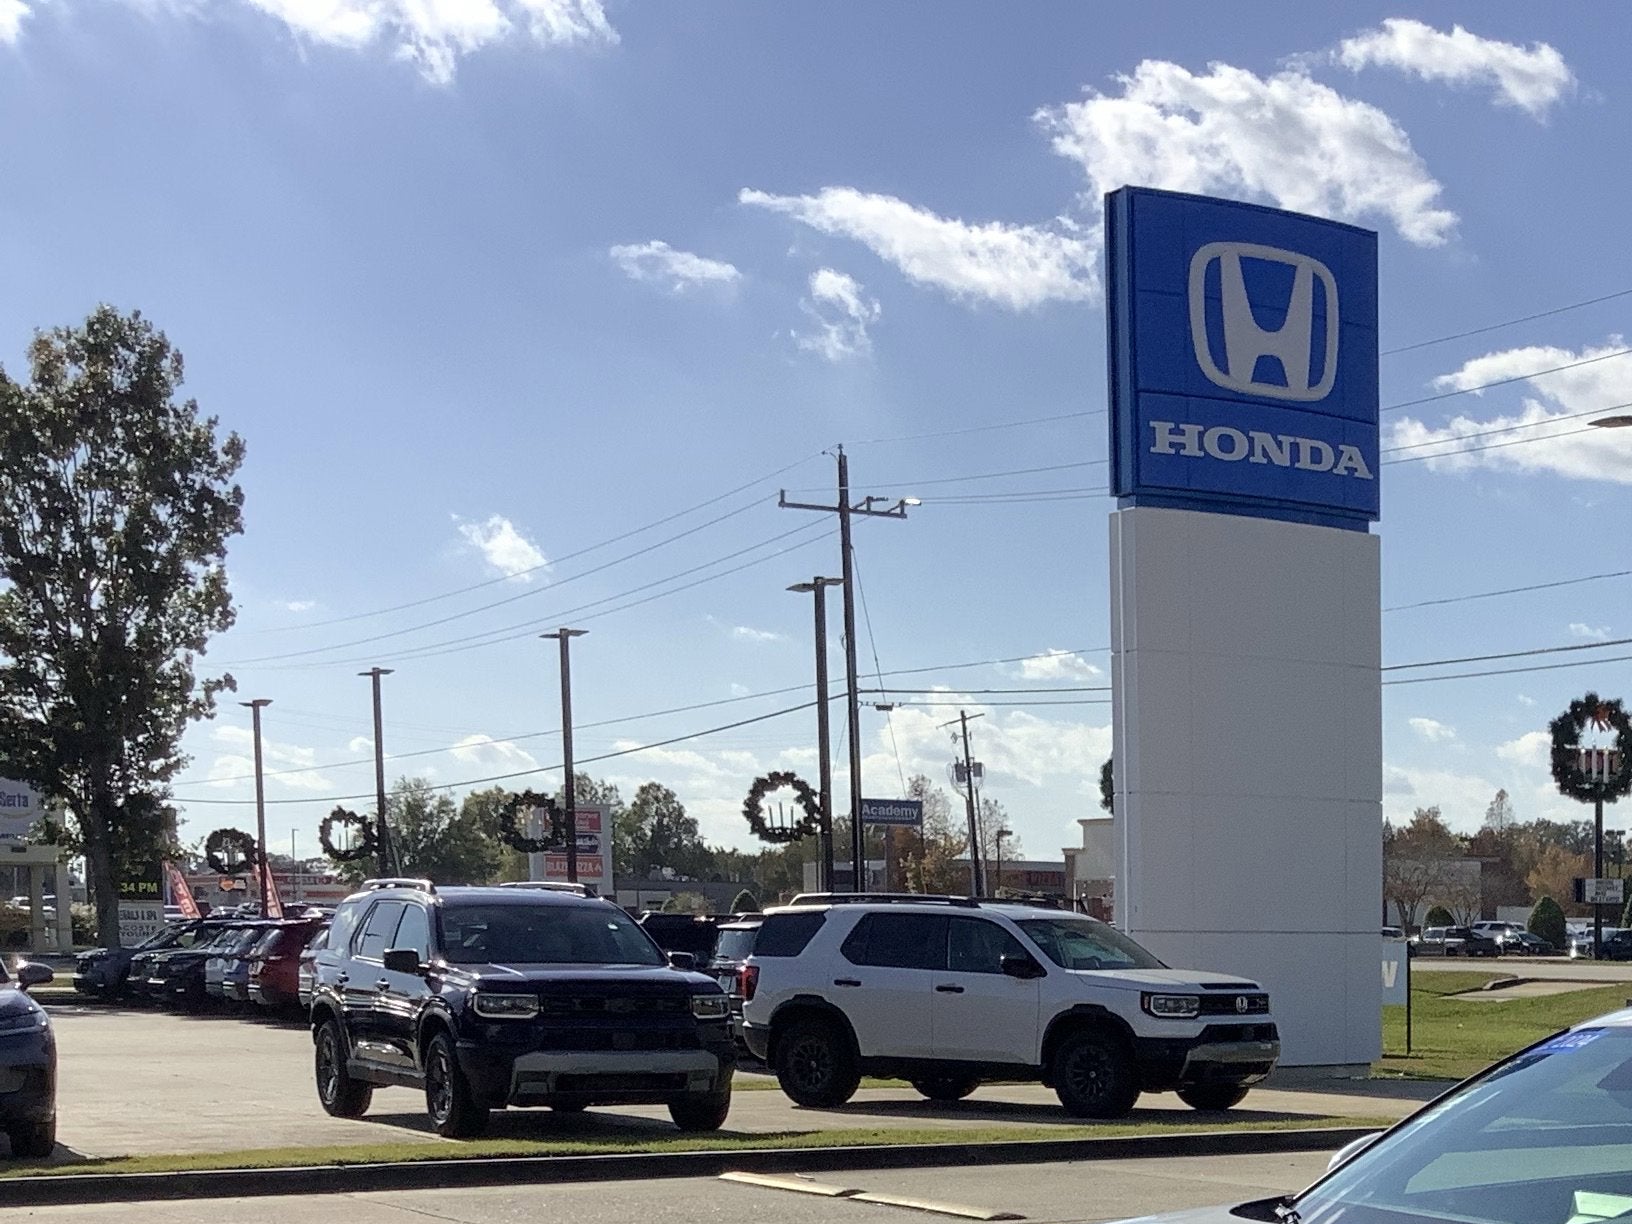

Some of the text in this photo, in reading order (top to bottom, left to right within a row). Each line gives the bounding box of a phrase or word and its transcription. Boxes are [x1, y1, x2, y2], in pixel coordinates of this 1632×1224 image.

[1149, 421, 1374, 480] HONDA
[0, 792, 28, 808] Serta
[862, 804, 918, 819] Academy
[139, 883, 157, 893] PM
